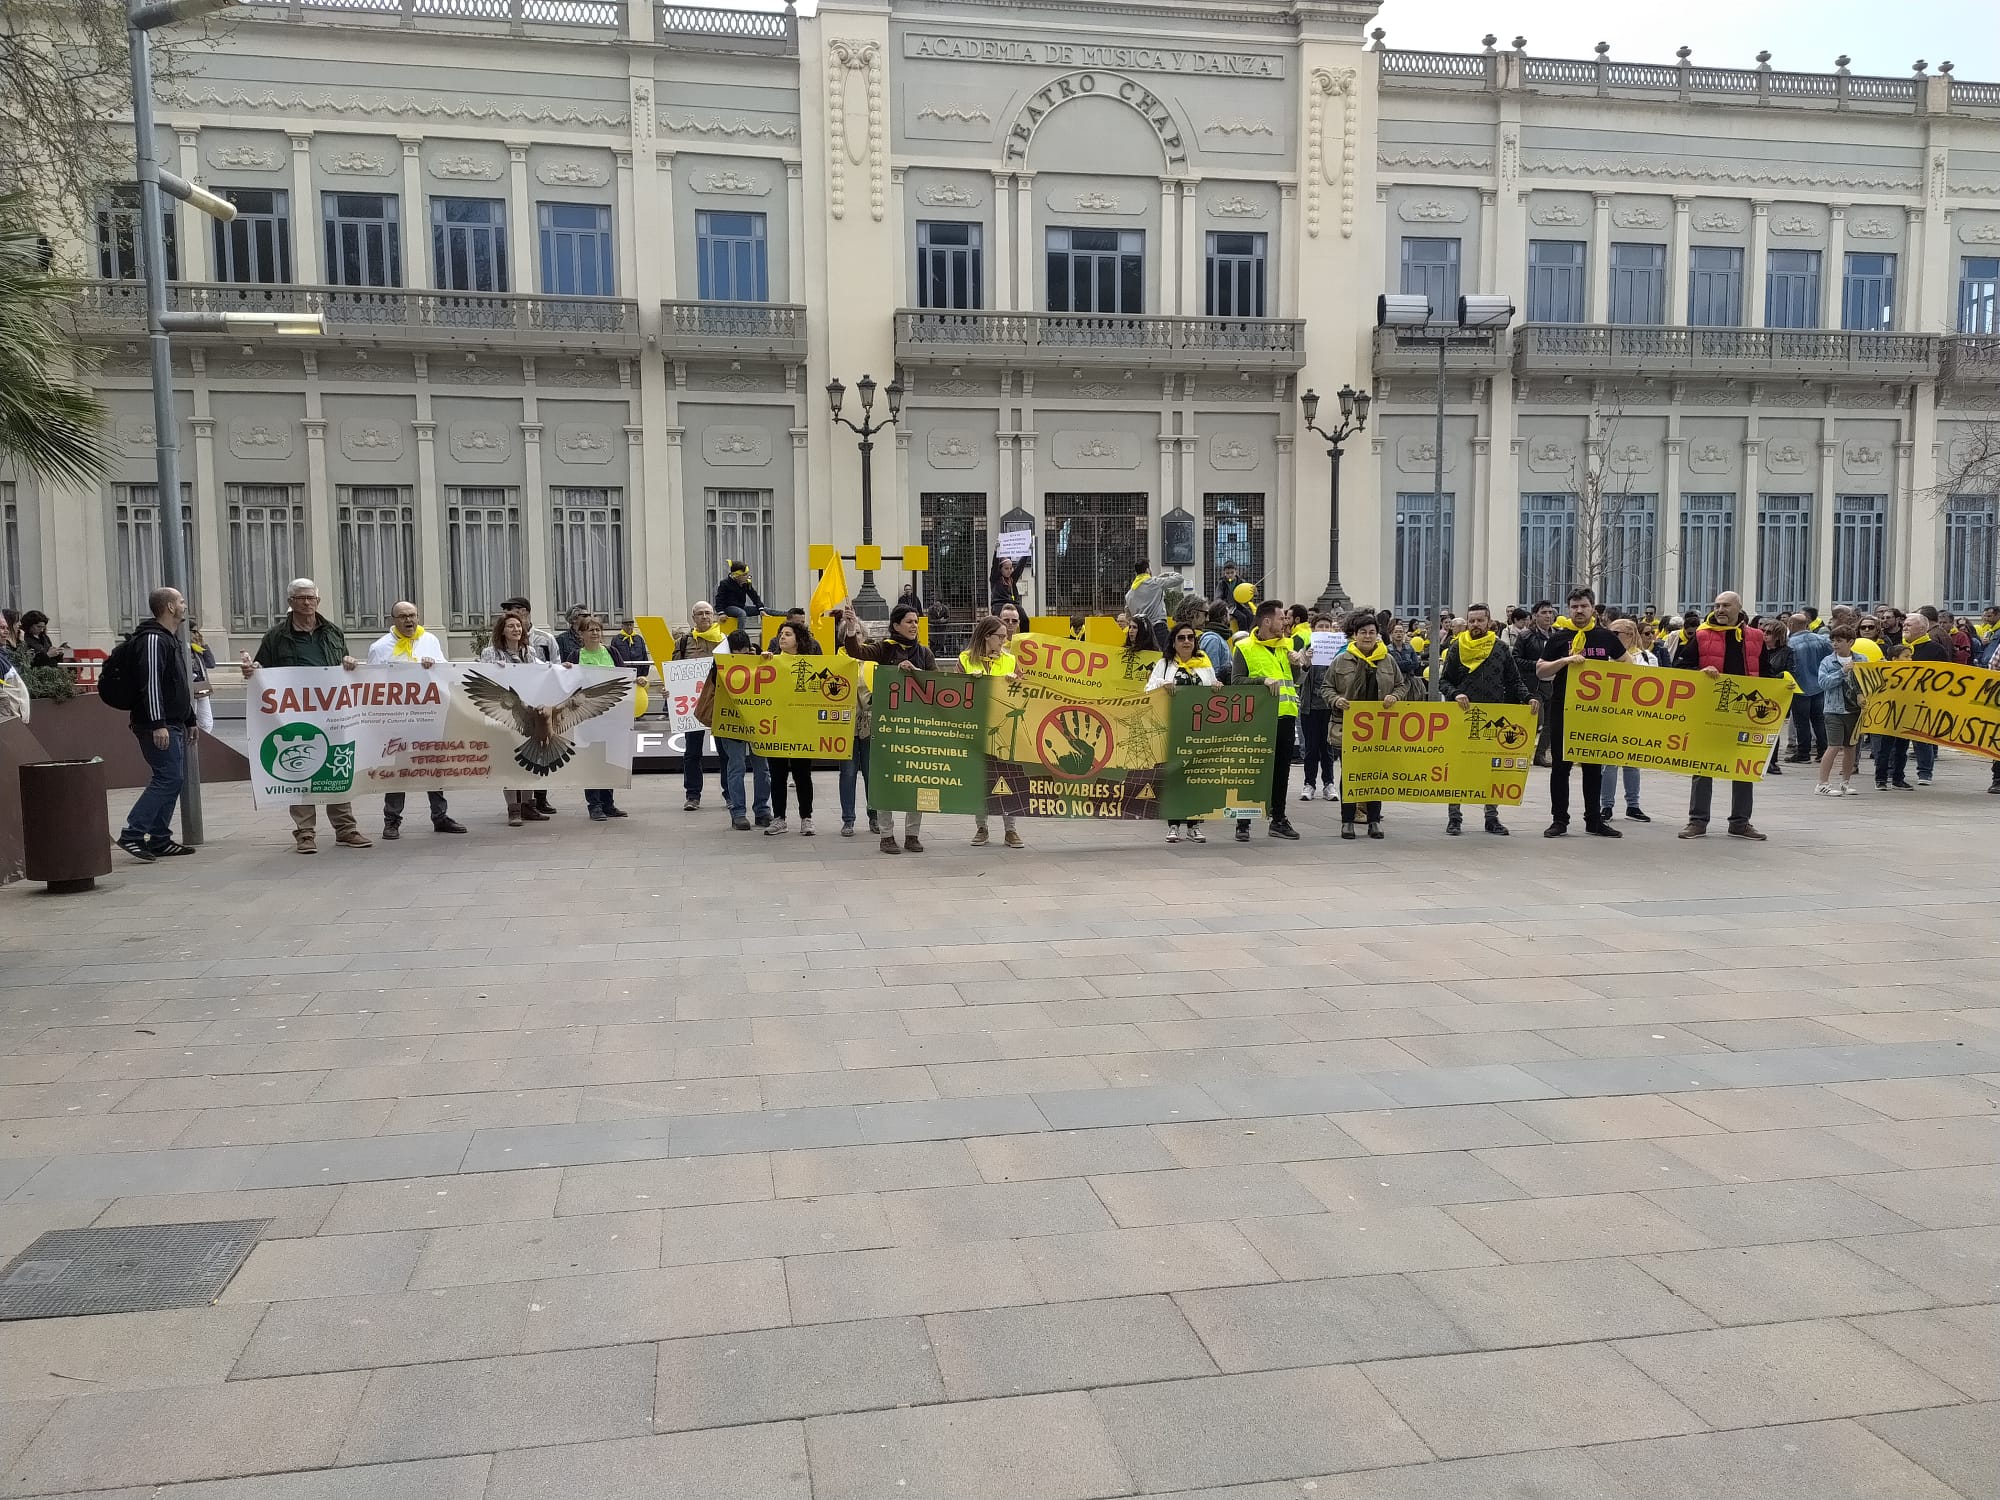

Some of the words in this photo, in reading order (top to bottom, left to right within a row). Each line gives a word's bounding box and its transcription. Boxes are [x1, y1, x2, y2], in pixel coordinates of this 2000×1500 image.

[916, 38, 1036, 62] ACADEMIA
[1045, 45, 1074, 64] DE
[1082, 47, 1166, 70] MUSICA
[1172, 52, 1186, 70] Y
[1193, 53, 1273, 76] DANZA
[1007, 74, 1096, 160] TEATRO
[1119, 82, 1187, 164] CHAPI
[1017, 639, 1109, 677] STOP
[1038, 671, 1063, 682] SOLAR
[1065, 676, 1103, 688] VINALOPÓ
[1858, 666, 1976, 697] NUESTROS
[260, 682, 441, 714] SALVATIERRA
[889, 676, 974, 709] ¡No!
[1575, 670, 1696, 709] STOP
[1191, 694, 1255, 731] ¡Sí!
[1575, 703, 1600, 713] PLAN
[1601, 706, 1634, 716] SOLAR
[1636, 710, 1687, 723] VINALOPÓ
[1862, 700, 1906, 730] SON
[759, 716, 777, 736] SÍ
[879, 714, 887, 722] A
[913, 716, 979, 730] Implantación
[1351, 711, 1450, 742] STOP
[879, 725, 892, 733] de
[913, 727, 975, 740] Renovables:
[1185, 733, 1250, 744] Paralización
[1253, 734, 1268, 743] de
[1569, 731, 1619, 744] ENERGÍA
[1621, 736, 1663, 749] SOLAR
[1666, 732, 1691, 752] SÍ
[411, 740, 465, 751] DEFENSA
[469, 740, 490, 751] DEL
[819, 736, 846, 753] NO
[890, 743, 968, 758] INSOSTENIBLE
[1176, 747, 1193, 755] las
[1196, 744, 1272, 755] autorizaciones
[1351, 745, 1373, 753] PLAN
[1374, 745, 1402, 753] SOLAR
[1403, 745, 1445, 754] VINALOPÓ
[905, 760, 951, 771] INJUSTA
[1182, 759, 1190, 767] y
[1192, 755, 1235, 764] licencias
[1249, 755, 1265, 764] las
[1567, 747, 1625, 760] ATENTADO
[1627, 752, 1731, 773] MEDIOAMBIENTAL
[1183, 765, 1261, 776] macro-plantas
[1348, 769, 1389, 782] ENERGÍA
[1391, 772, 1428, 782] SOLAR
[1430, 762, 1449, 782] SÍ
[893, 774, 963, 786] IRRACIONAL
[1029, 780, 1110, 798] RENOVABLES
[1186, 776, 1255, 785] fotovoltaicas
[265, 784, 309, 795] Villena
[1347, 787, 1395, 797] ATENTADO
[1397, 787, 1487, 799] MEDIOAMBIENTAL
[1491, 783, 1522, 800] NO
[1029, 798, 1067, 816] PERO
[1071, 801, 1095, 817] NO
[1098, 799, 1122, 817] ASÍ
